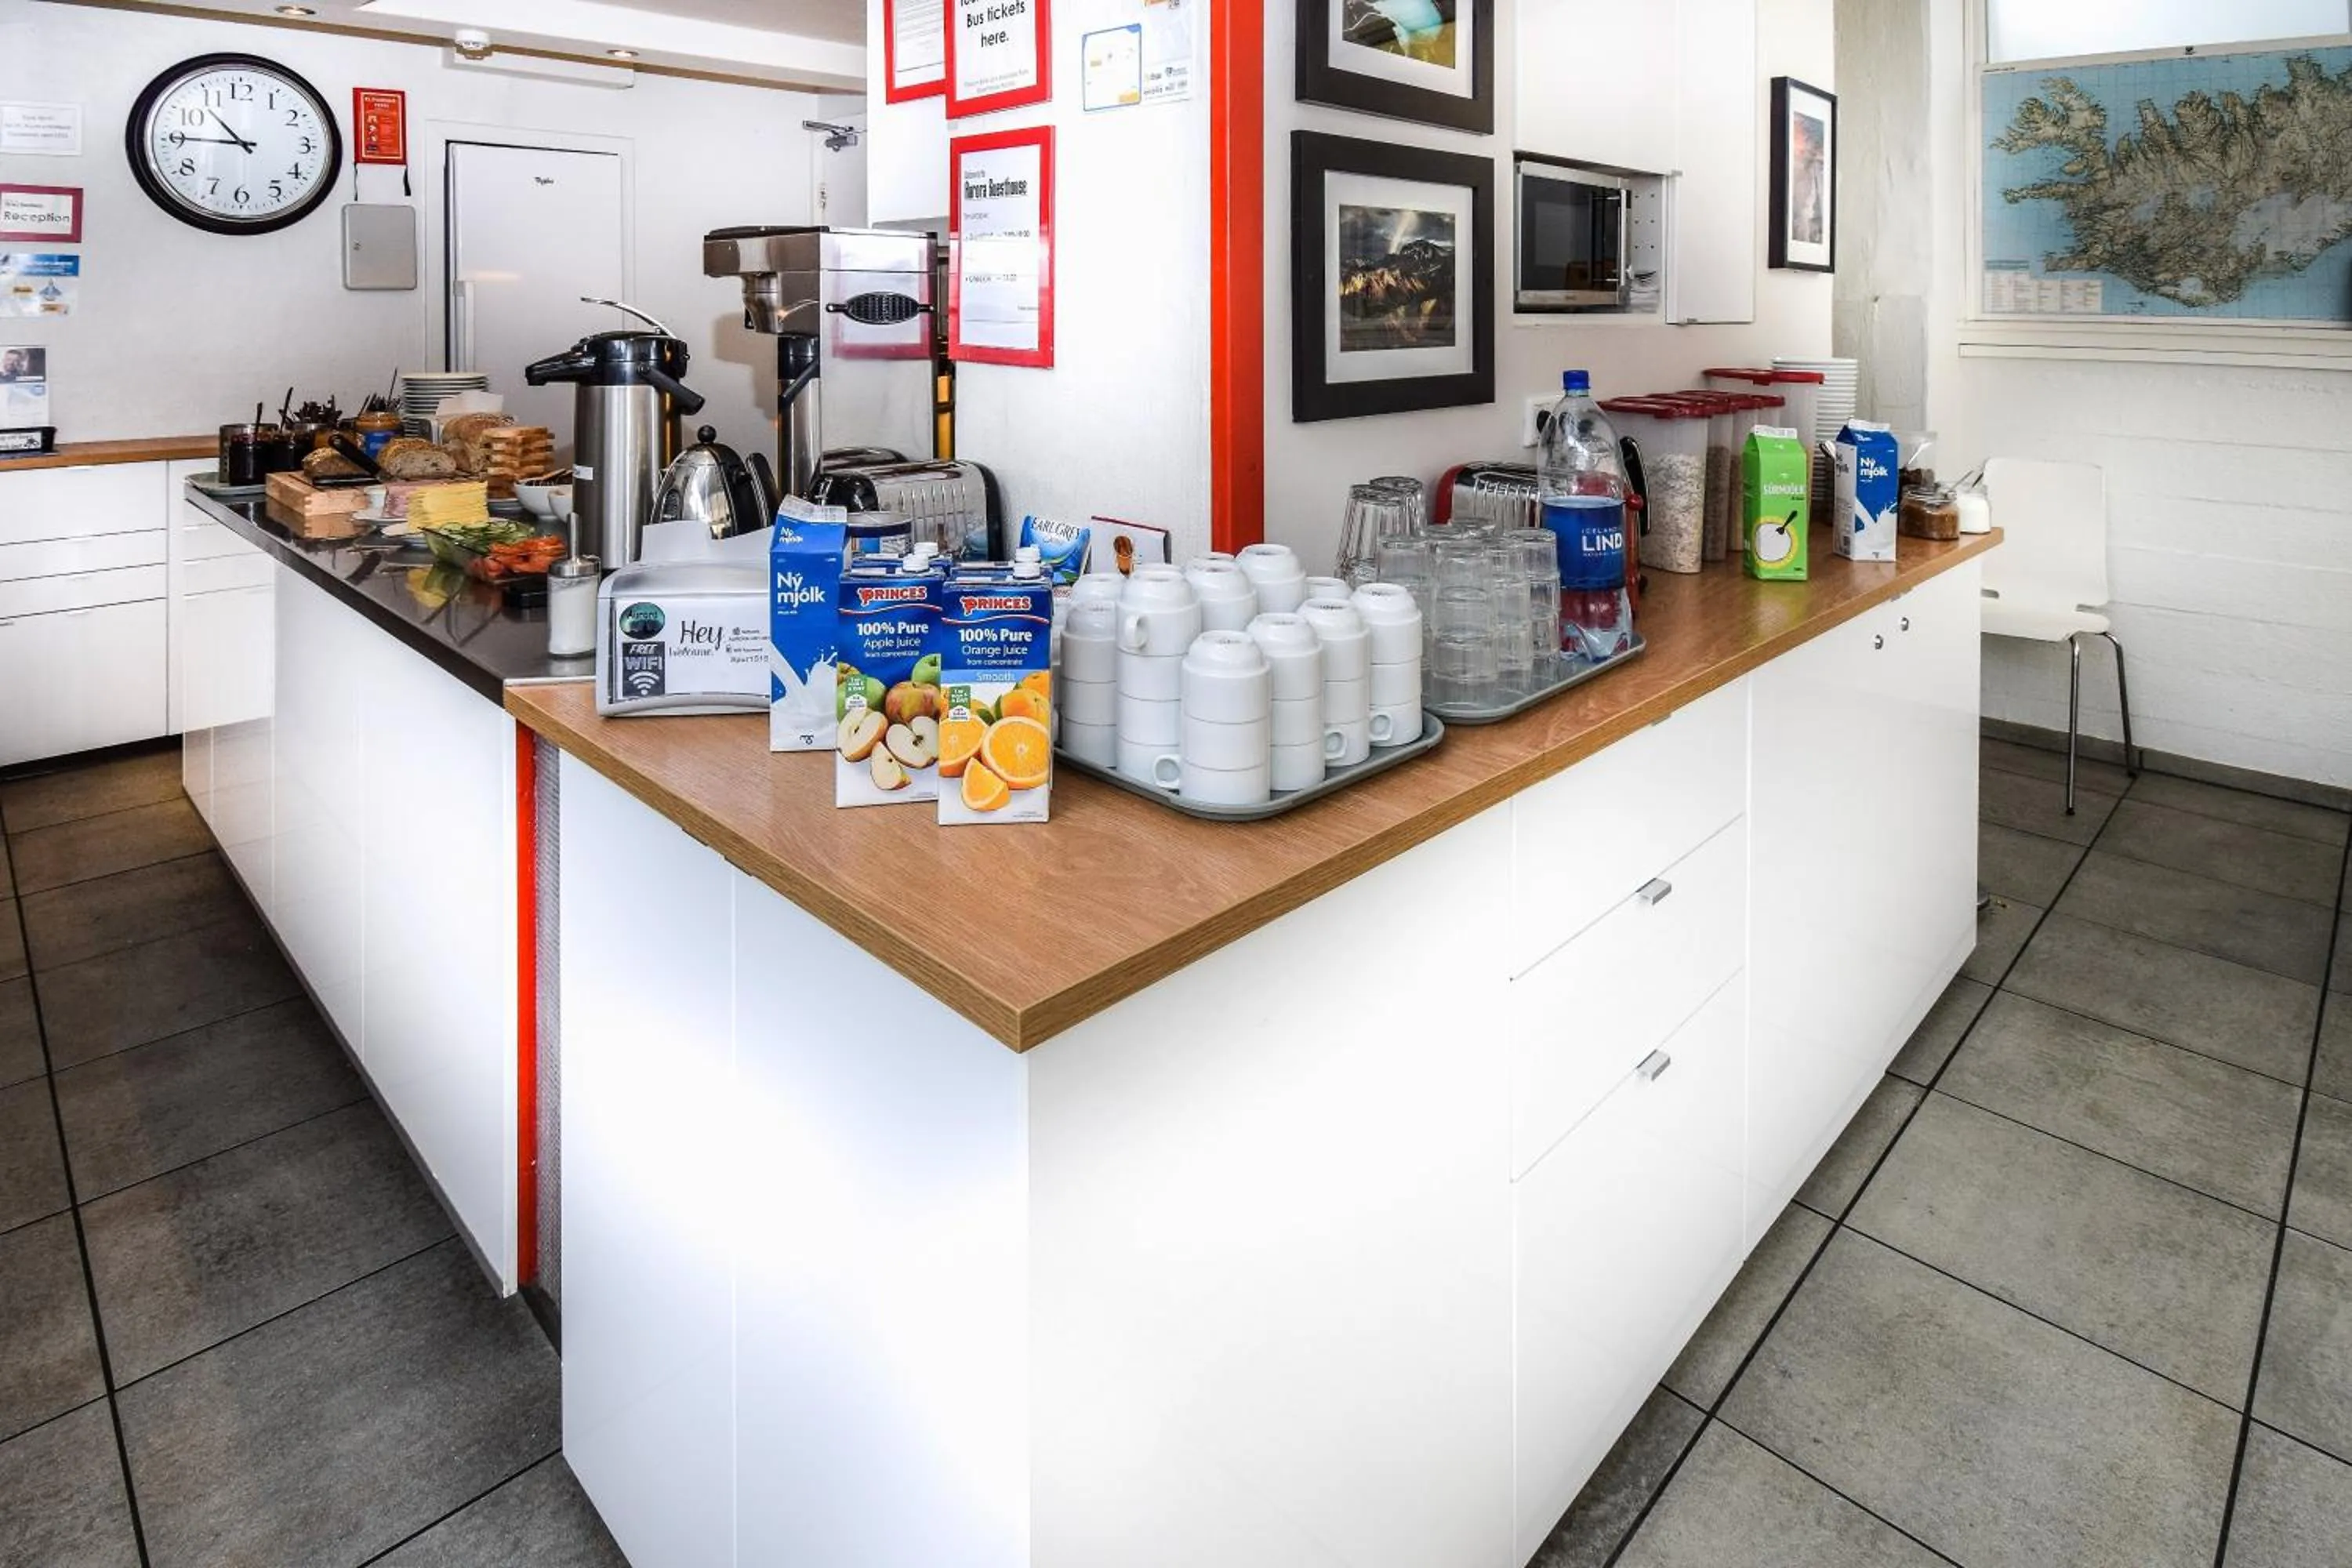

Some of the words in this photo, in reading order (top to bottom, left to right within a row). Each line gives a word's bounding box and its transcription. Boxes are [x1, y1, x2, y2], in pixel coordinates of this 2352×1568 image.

[967, 13, 983, 27] Bus
[987, 0, 1025, 21] tickets
[981, 30, 1009, 47] here.
[204, 88, 220, 107] 11
[230, 82, 252, 101] 12
[268, 92, 276, 110] 1
[180, 107, 205, 126] 10
[285, 109, 299, 126] 2
[169, 130, 186, 150] 9
[298, 136, 311, 154] 3
[180, 158, 195, 176] 8
[287, 162, 302, 180] 4
[206, 177, 220, 195] 7
[234, 183, 250, 203] 6
[268, 180, 281, 198] 5
[4, 211, 70, 223] Reception
[1582, 533, 1622, 551] LIND
[777, 572, 804, 592] Ný
[777, 586, 826, 608] mjólk
[858, 586, 927, 606] PRINCES
[960, 596, 1032, 615] PRINCES
[680, 620, 723, 651] Hey
[856, 622, 895, 636] 100%
[898, 622, 929, 634] Pure
[958, 628, 998, 642] 100%
[1000, 628, 1033, 642] Pure
[629, 644, 658, 655] FREE
[863, 638, 895, 650] Apple
[896, 637, 921, 649] Juice
[961, 644, 1001, 657] Orange
[1004, 644, 1029, 657] Juice
[624, 656, 663, 670] WIFI
[976, 671, 1015, 681] Smooth
